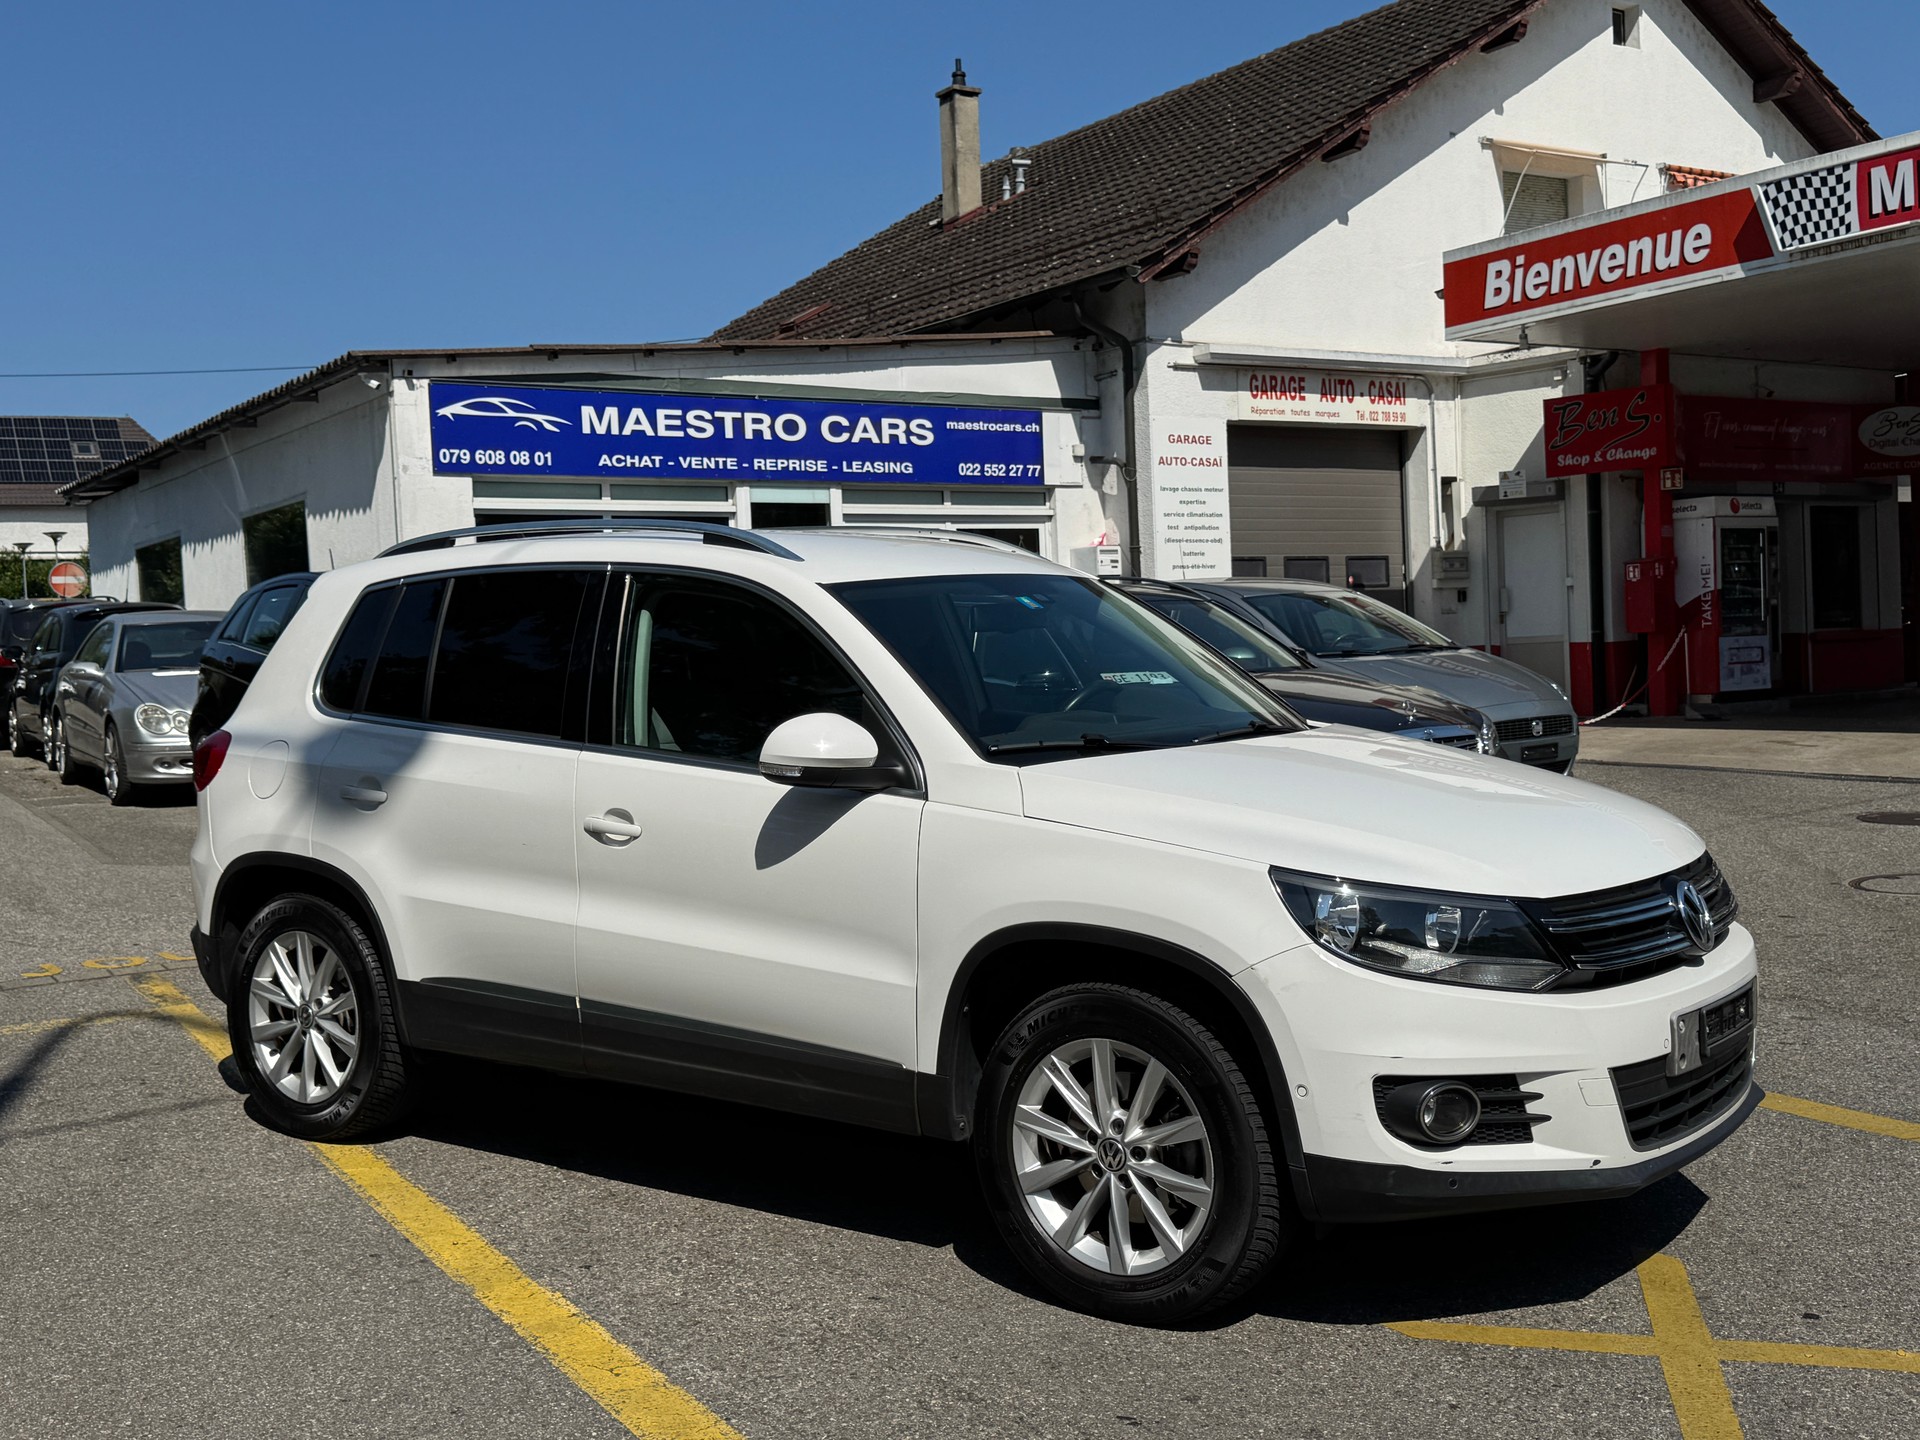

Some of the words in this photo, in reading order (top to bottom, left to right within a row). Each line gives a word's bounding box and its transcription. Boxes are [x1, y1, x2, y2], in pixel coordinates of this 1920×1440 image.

[1870, 158, 1918, 216] M
[1483, 223, 1713, 310] Bienvenue
[1250, 374, 1306, 401] GARAGE
[1320, 378, 1355, 404] AUTO
[1251, 406, 1286, 416] Réparation
[1290, 409, 1311, 417] toutes
[1315, 411, 1340, 419] marques
[1369, 411, 1379, 421] 022
[581, 405, 807, 442] MAESTRO
[820, 415, 935, 446] CARS
[946, 421, 1040, 433] maestrocars.ch
[1168, 434, 1212, 445] GARAGE
[1902, 437, 1920, 446] Cha
[439, 448, 471, 464] 079
[475, 449, 506, 465] 608
[509, 450, 531, 466] 08
[534, 451, 552, 466] 01
[598, 454, 664, 468] ACHAT
[678, 456, 738, 470] VENTE
[753, 458, 828, 472] REPRISE
[842, 460, 914, 474] LEASING
[1557, 454, 1590, 467] Shop
[1594, 450, 1603, 462] &
[1606, 447, 1657, 461] Change
[958, 463, 981, 476] 022
[984, 463, 1006, 477] 552
[1008, 464, 1024, 477] 27
[1026, 465, 1041, 477] 77
[1671, 504, 1697, 513] selecta
[1740, 501, 1762, 510] selecta
[1700, 563, 1711, 588] ME!
[1701, 591, 1713, 629] TAKE
